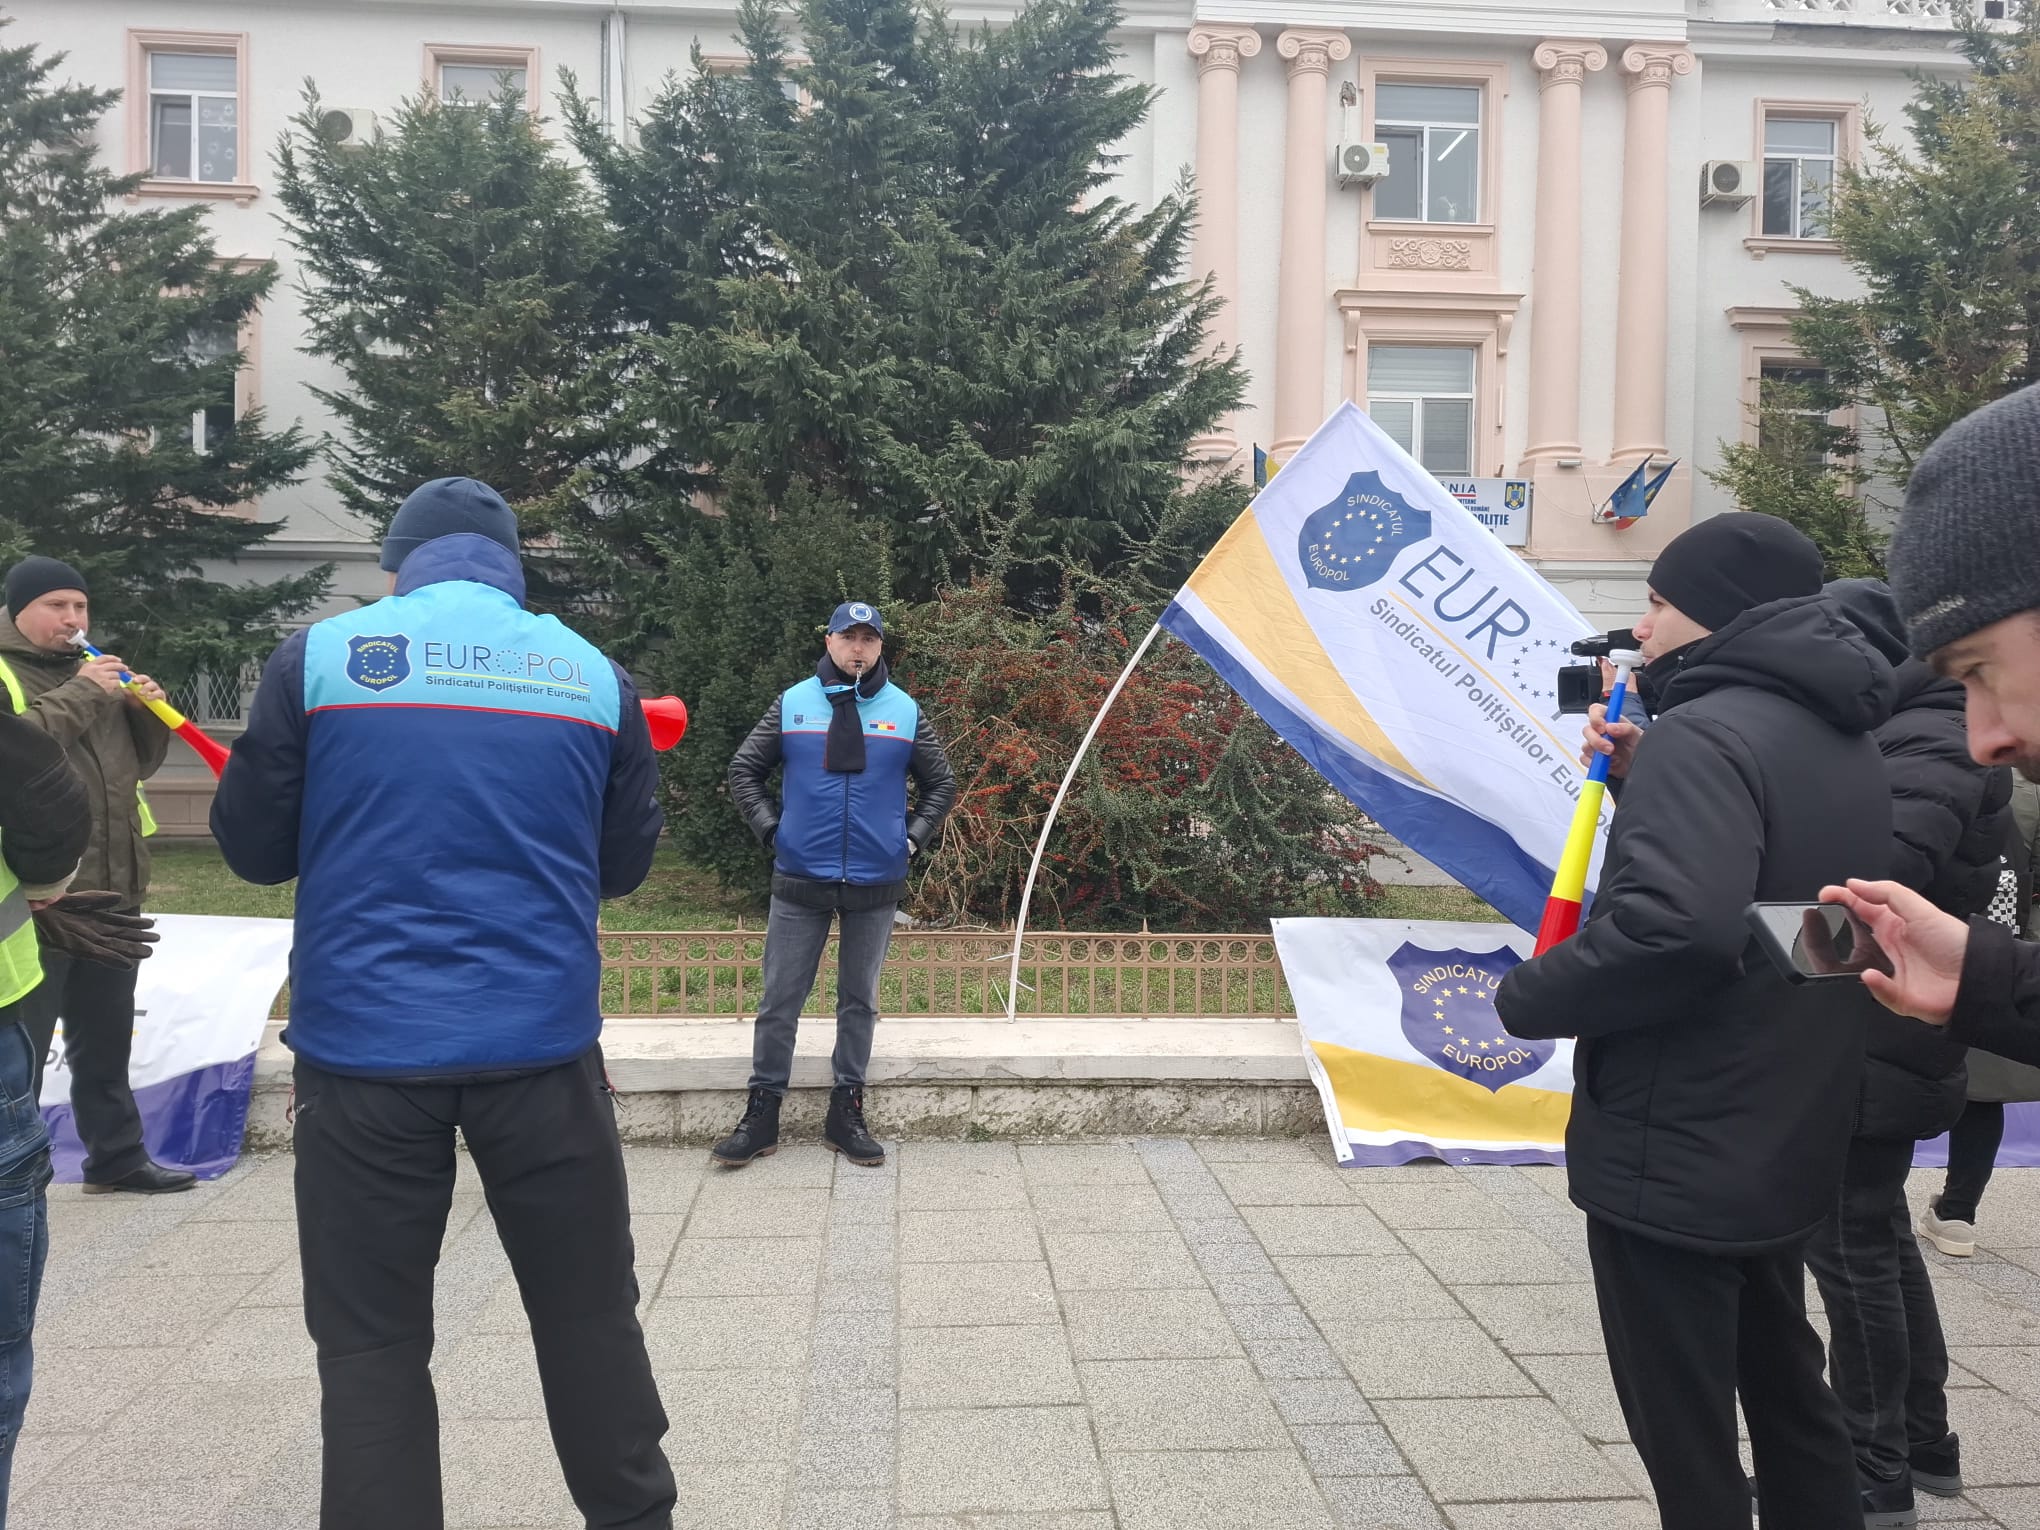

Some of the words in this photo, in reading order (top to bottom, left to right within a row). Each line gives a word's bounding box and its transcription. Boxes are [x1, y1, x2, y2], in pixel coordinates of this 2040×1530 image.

[1347, 493, 1404, 537] SINDICATUL
[1308, 543, 1350, 582] EUROPOL
[356, 640, 400, 653] SINDICATUL
[359, 674, 399, 685] EUROPOL
[425, 675, 484, 690] Sindicatul
[487, 680, 544, 695] Polițiștilor
[547, 687, 591, 703] Europeni
[1370, 598, 1459, 678] Sindicatul
[1454, 672, 1555, 766] Polițiștilor
[1413, 964, 1501, 995] SINDICATU
[1441, 1043, 1532, 1072] EUROPOL
